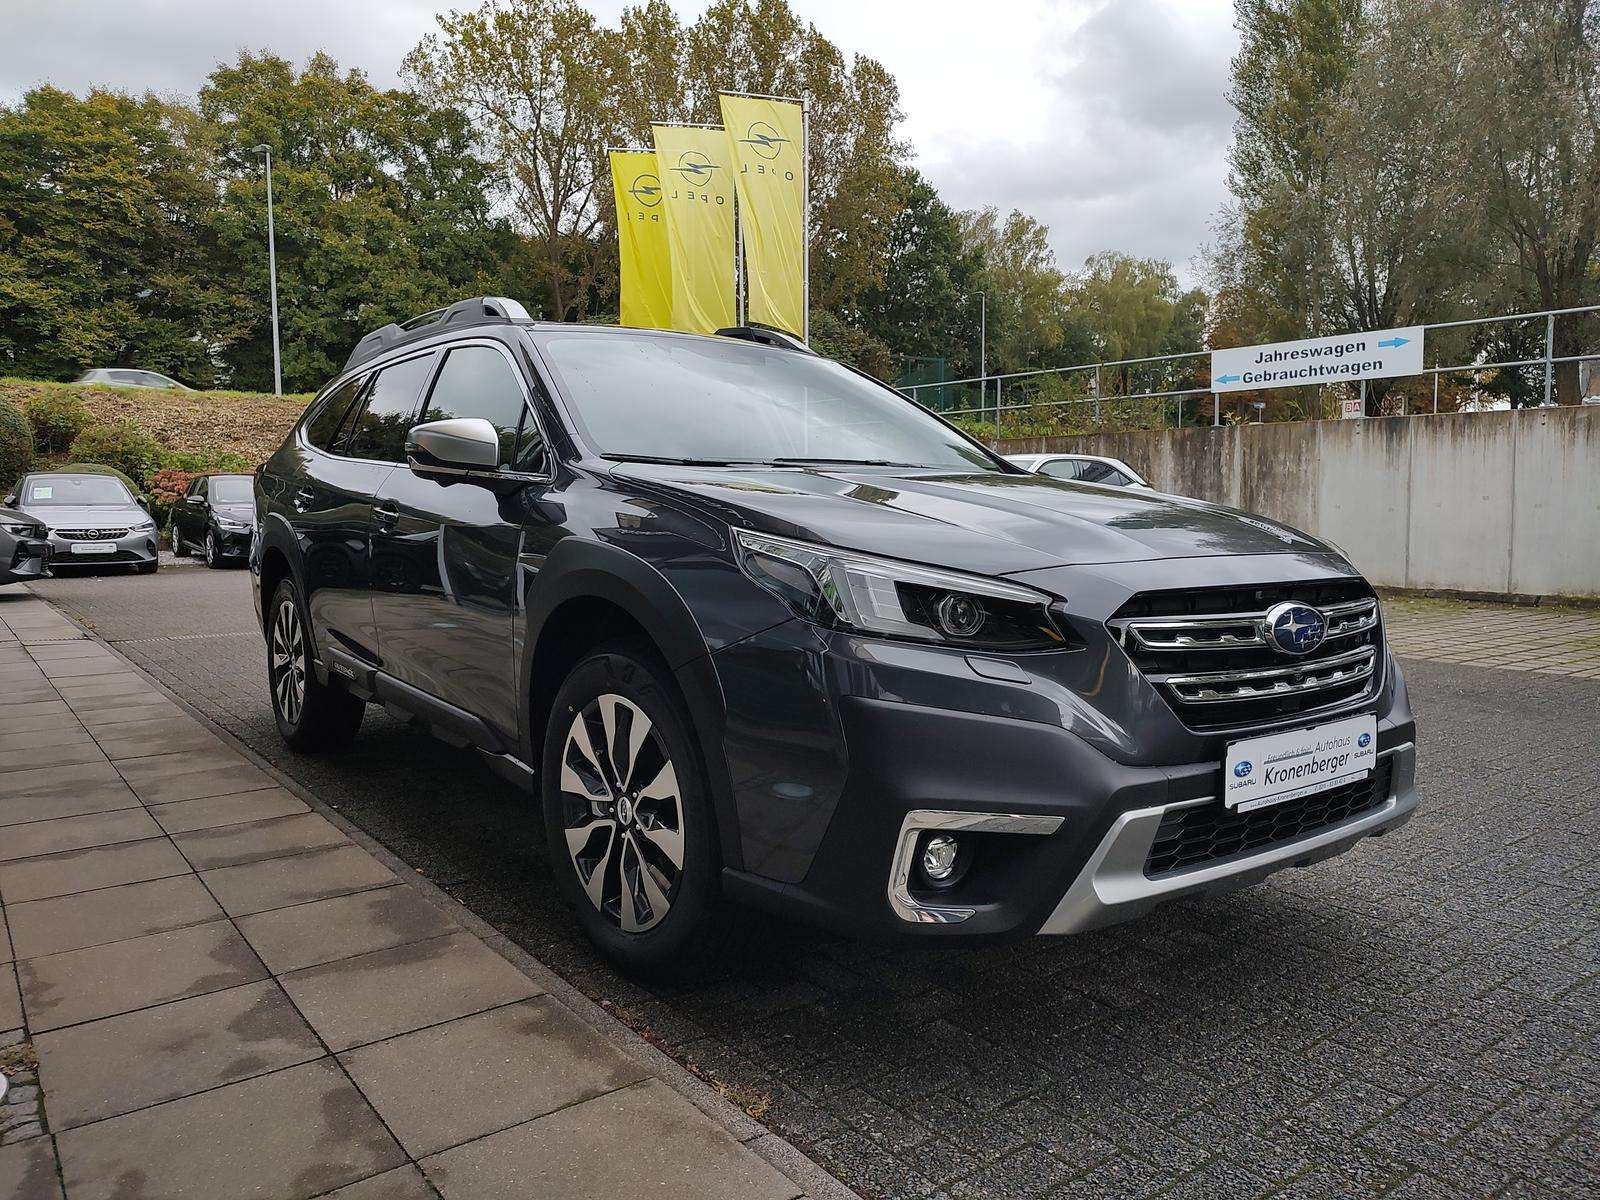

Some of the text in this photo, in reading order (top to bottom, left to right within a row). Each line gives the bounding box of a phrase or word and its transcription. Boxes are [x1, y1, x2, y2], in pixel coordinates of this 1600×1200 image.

[1254, 341, 1366, 364] Jahreswagen
[1242, 359, 1383, 384] Gebrauchtwagen
[1314, 736, 1351, 753] Autohaus
[1353, 749, 1375, 759] SUBARU
[1263, 752, 1350, 786] Kronenberger
[1229, 778, 1257, 791] SUBARU
